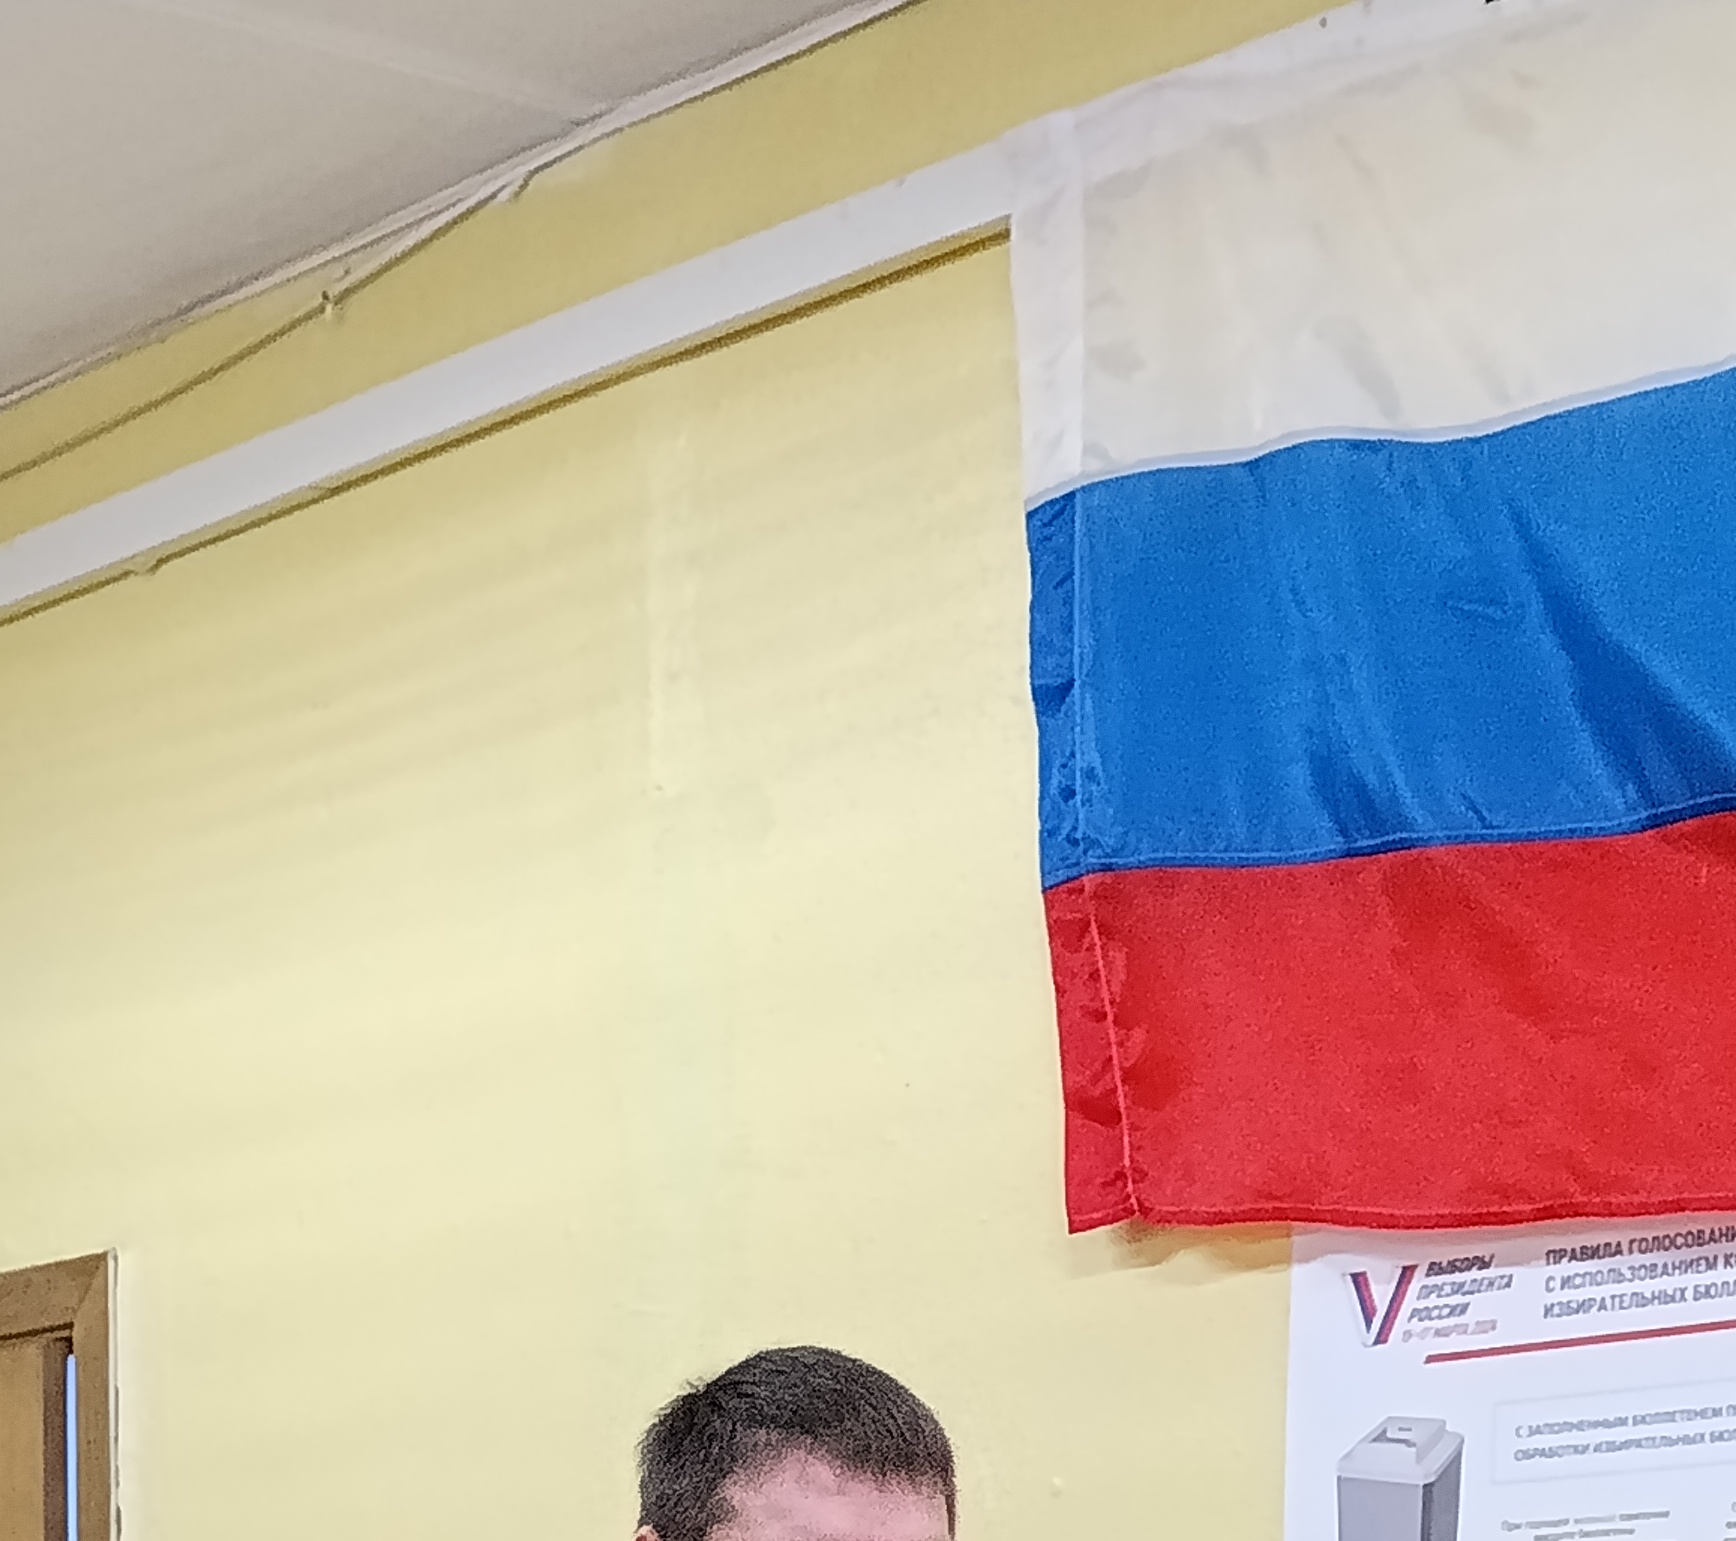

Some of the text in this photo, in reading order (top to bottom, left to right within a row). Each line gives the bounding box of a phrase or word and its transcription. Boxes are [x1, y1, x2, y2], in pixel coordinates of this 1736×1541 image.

[1425, 1253, 1495, 1278] ВЫБОРЫ
[1545, 1240, 1624, 1267] ПРАВИЛА
[1544, 1275, 1556, 1293] С
[1560, 1253, 1718, 1291] ИСПОЛЬЗОВАНИЕМ
[1416, 1273, 1513, 1301] ПРЕЗИДЕНТА
[1407, 1301, 1471, 1323] РОССИИ
[1543, 1286, 1688, 1319] ИЗБИРАТЕЛЬНЫХ
